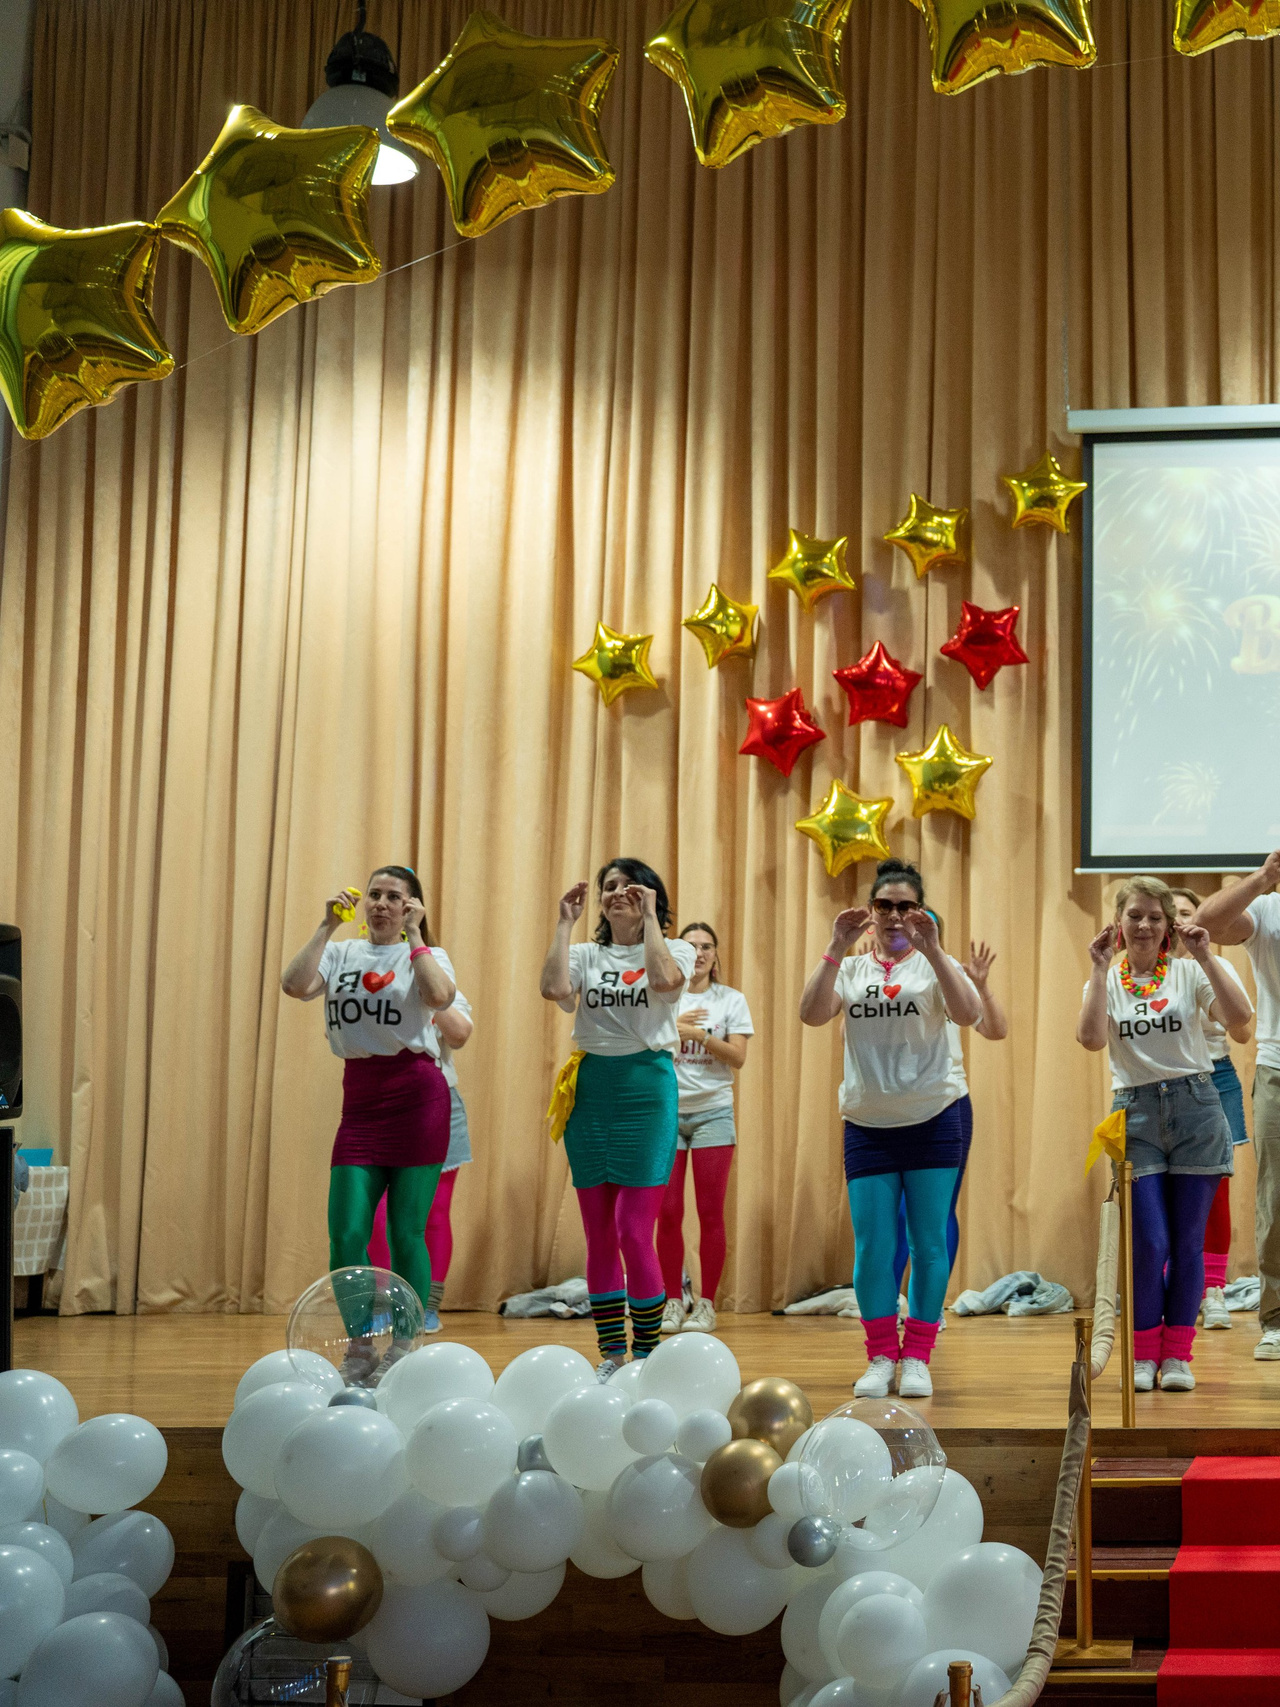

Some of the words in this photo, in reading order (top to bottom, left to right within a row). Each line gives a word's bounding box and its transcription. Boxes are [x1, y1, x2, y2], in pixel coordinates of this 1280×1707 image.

[335, 970, 362, 994] Я
[598, 971, 620, 987] Я
[586, 988, 649, 1009] СЫНА
[865, 985, 879, 998] Я
[328, 998, 402, 1031] ДОЧЬ
[849, 1001, 920, 1019] СЫНА
[1134, 1002, 1148, 1016] Я
[1119, 1015, 1182, 1040] ДОЧЬ
